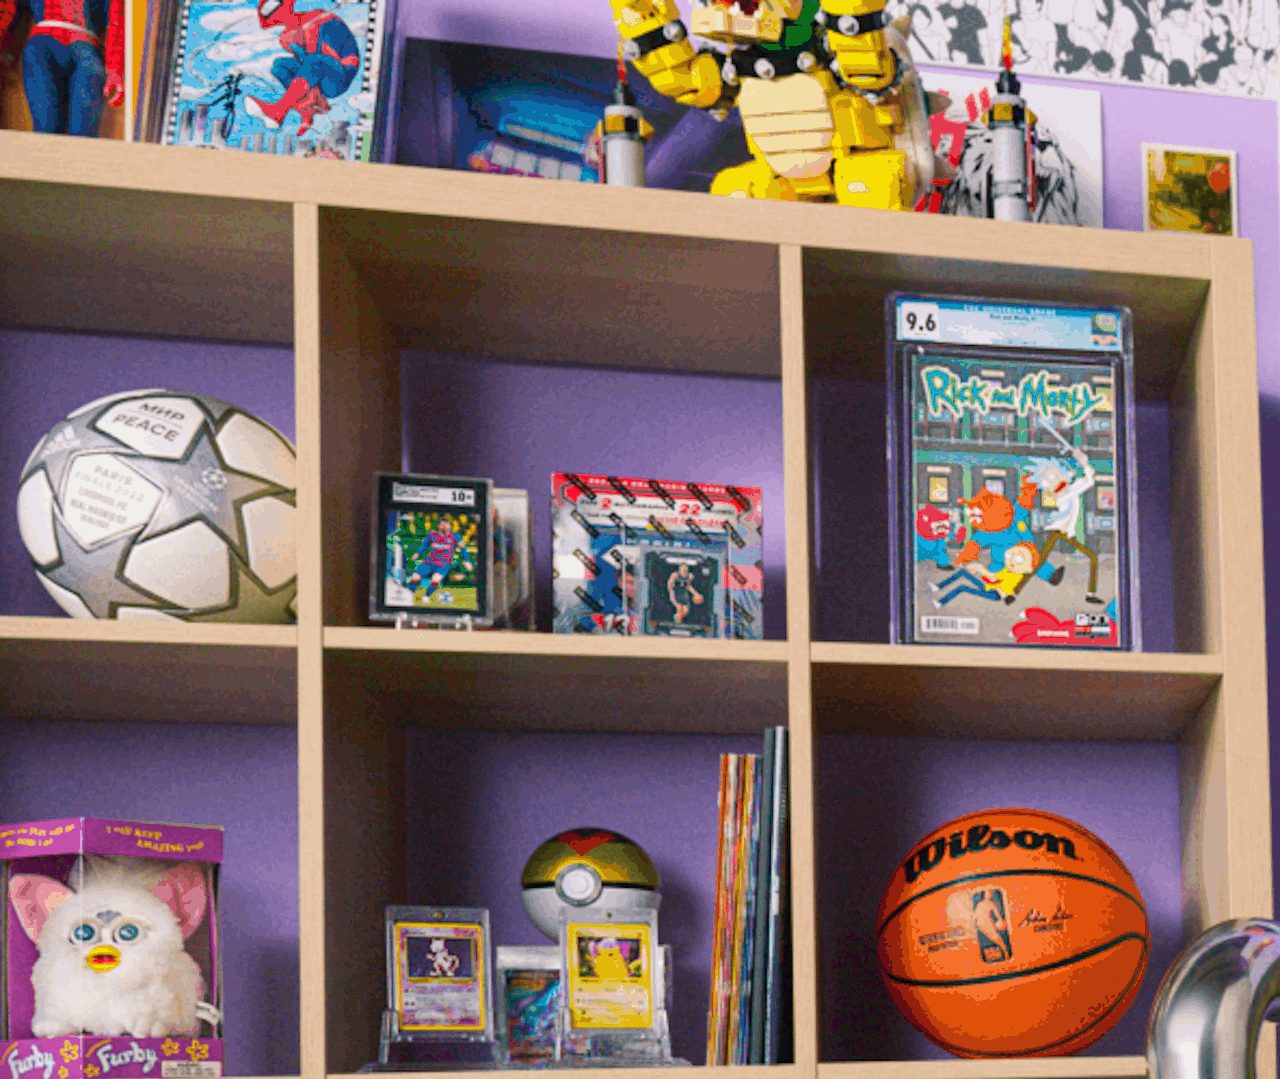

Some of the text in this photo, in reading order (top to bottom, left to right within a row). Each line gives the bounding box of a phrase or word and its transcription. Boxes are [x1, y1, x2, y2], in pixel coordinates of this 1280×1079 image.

[905, 312, 937, 332] 9.6
[112, 413, 180, 443] PEACE
[678, 504, 701, 516] 22
[904, 823, 1079, 884] Wilson
[96, 1041, 160, 1074] Furby
